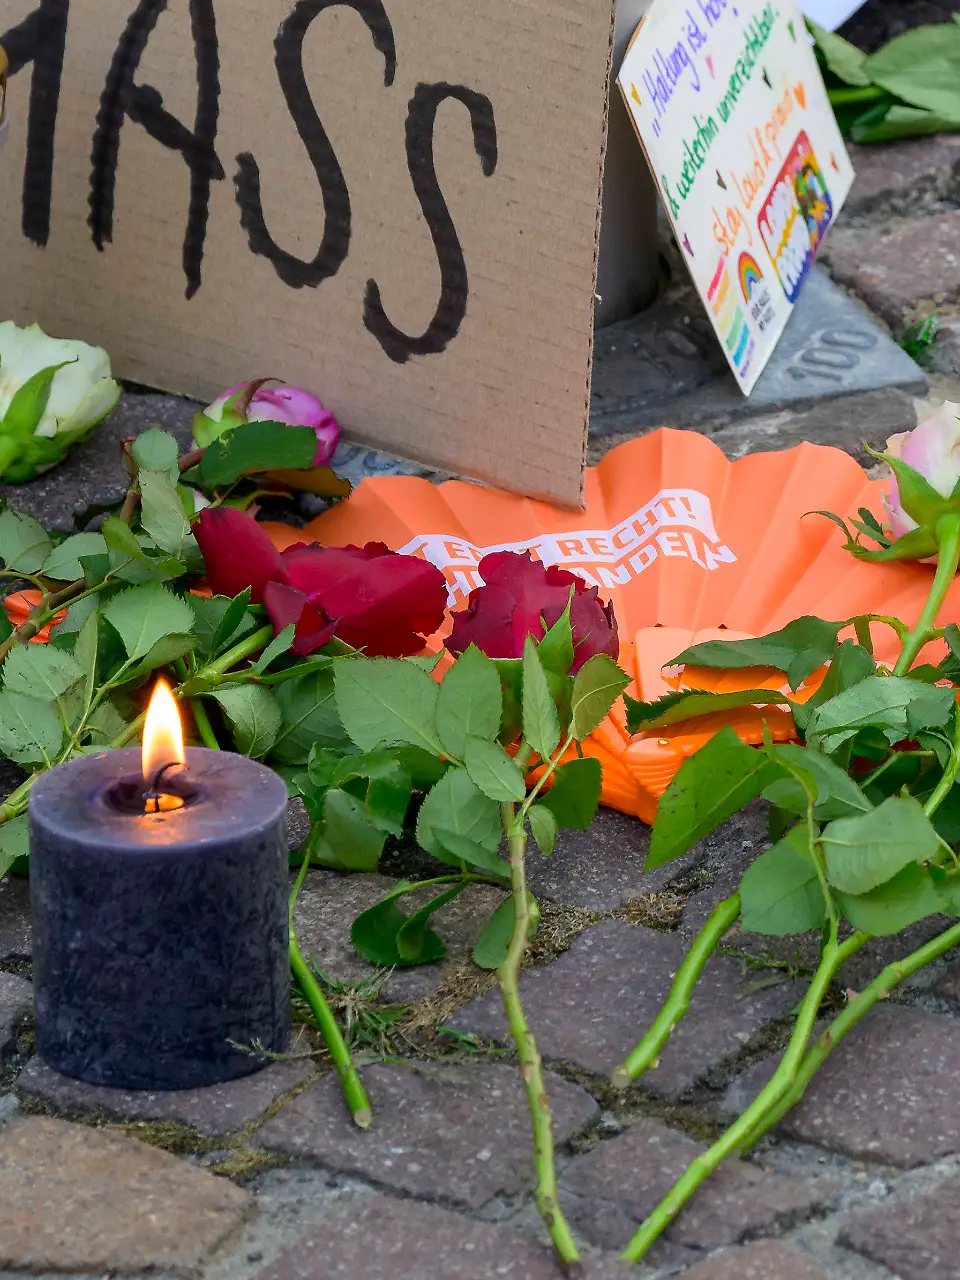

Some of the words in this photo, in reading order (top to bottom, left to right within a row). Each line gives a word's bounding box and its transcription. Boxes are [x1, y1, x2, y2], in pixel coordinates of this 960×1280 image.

[681, 9, 708, 54] ist
[661, 174, 680, 220] &
[676, 114, 720, 200] weiterhin
[711, 205, 753, 256] stay
[786, 328, 879, 383] 100
[556, 496, 697, 557] RECHT!
[567, 531, 738, 589] ANDELN
